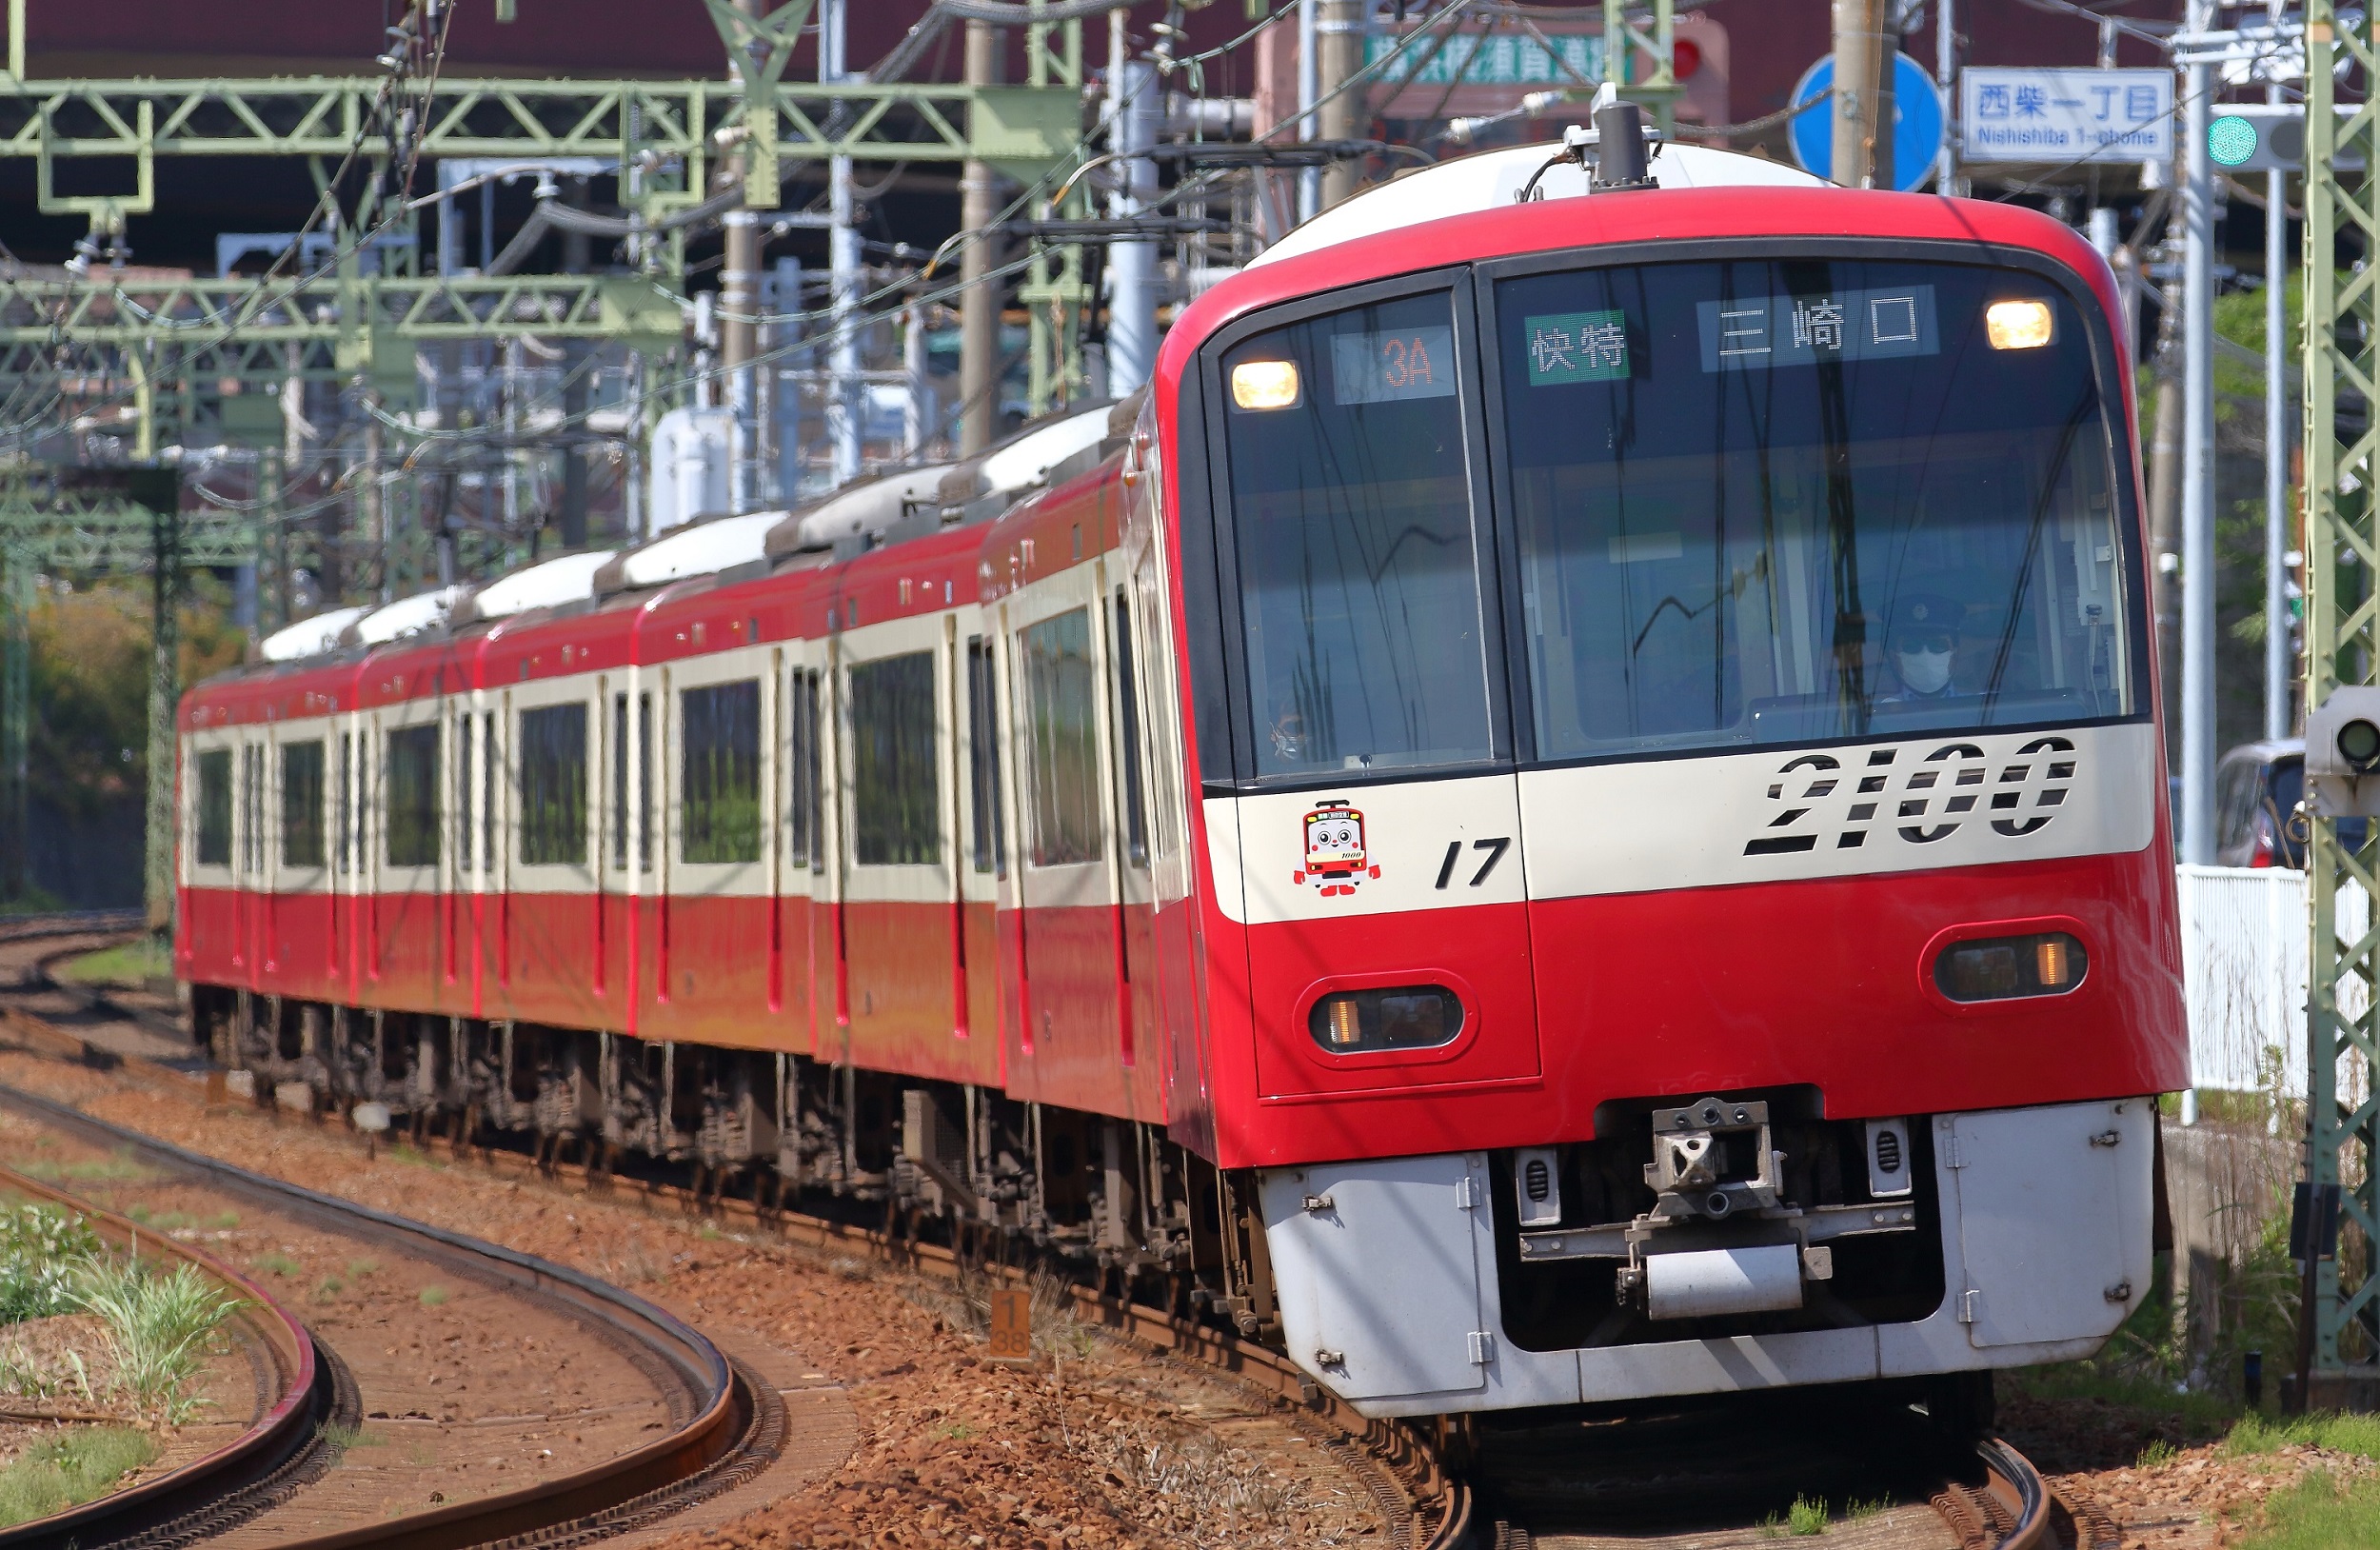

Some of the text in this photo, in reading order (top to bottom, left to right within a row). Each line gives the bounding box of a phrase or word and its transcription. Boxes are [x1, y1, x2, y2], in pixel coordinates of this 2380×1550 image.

[1978, 84, 2158, 121] 西柴一丁目
[1978, 126, 2158, 145] Nishishiba 1-chome
[1531, 322, 1626, 372] 快特
[1718, 298, 1917, 356] 三崎口
[1383, 337, 1432, 387] 3A
[1743, 736, 2077, 856] 2100
[1435, 837, 1511, 890] 17
[1000, 1295, 1016, 1329] 1
[993, 1330, 1025, 1353] 38
